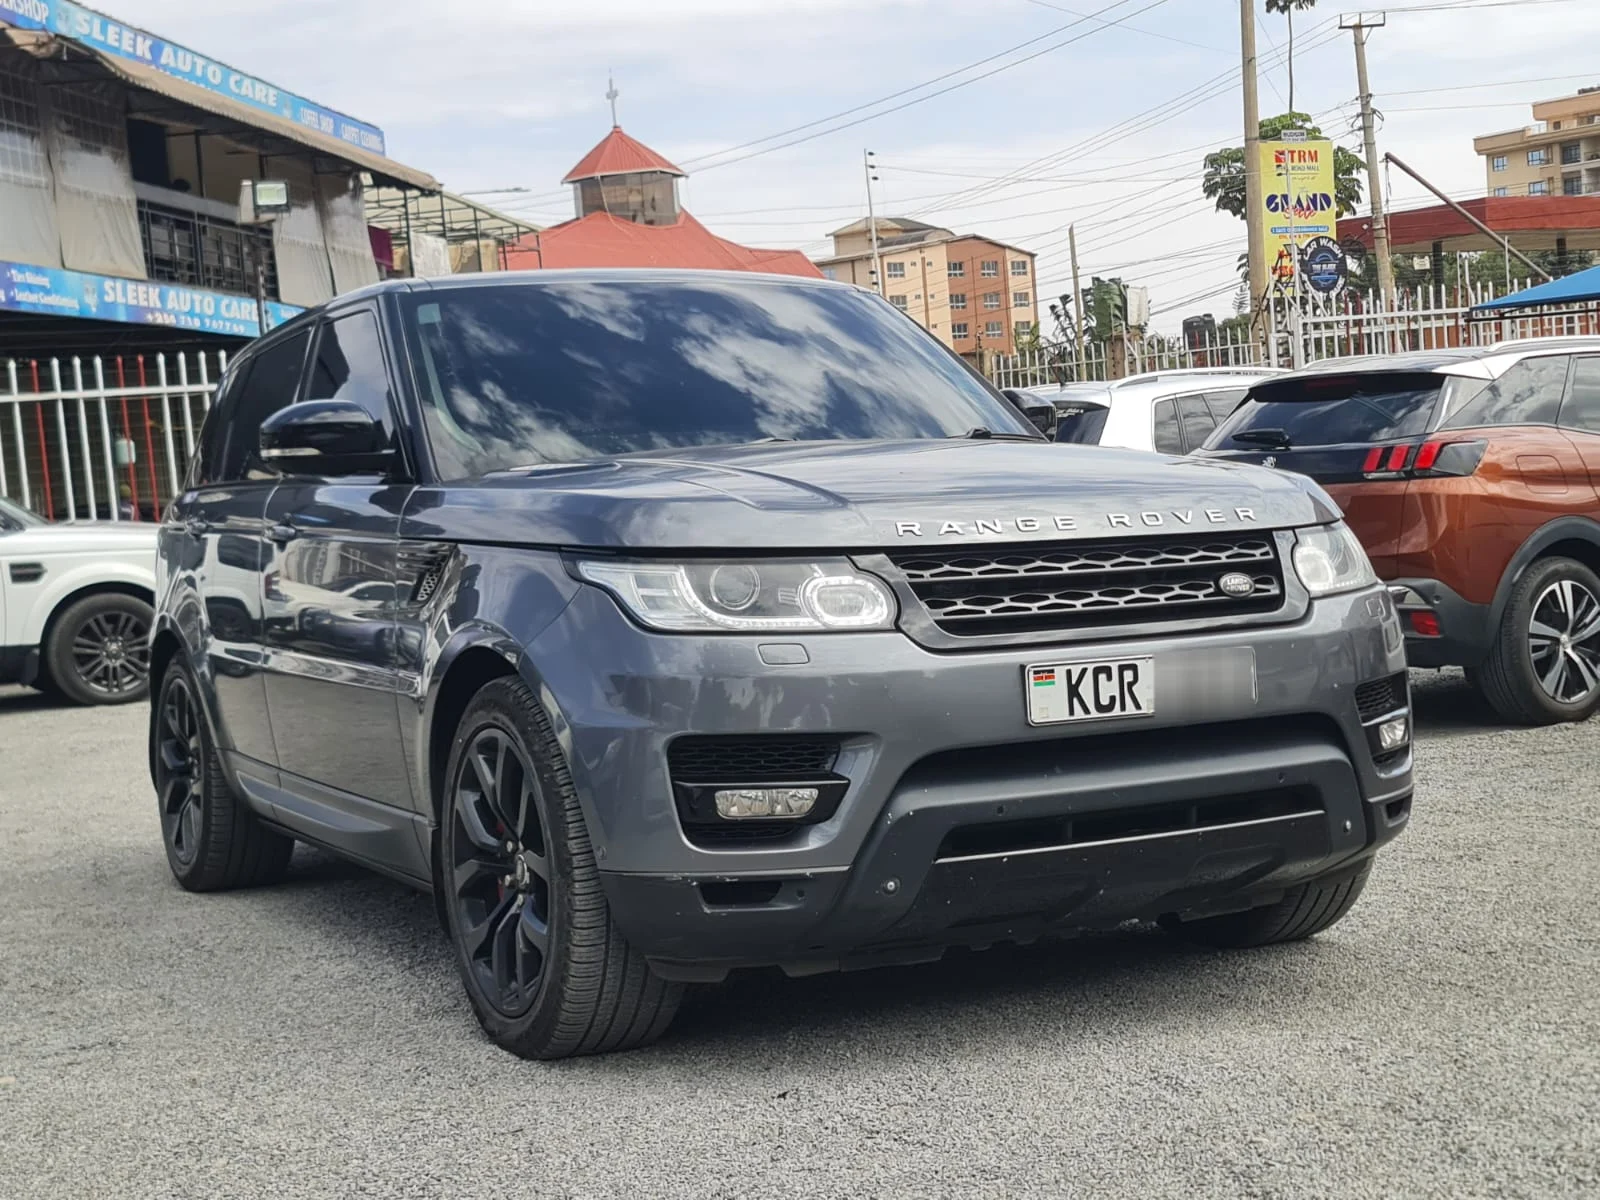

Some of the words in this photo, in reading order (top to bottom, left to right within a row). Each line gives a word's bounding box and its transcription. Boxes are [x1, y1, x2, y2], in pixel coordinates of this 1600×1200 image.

[76, 12, 153, 61] SLEEK
[160, 43, 223, 85] AUTO
[229, 75, 278, 106] CARE
[1288, 149, 1319, 164] TRM
[1265, 192, 1332, 213] GRAND
[1303, 240, 1318, 260] CAR
[1319, 237, 1344, 258] WASH
[103, 280, 161, 306] SLEEK
[166, 291, 215, 316] AUTO
[220, 301, 258, 323] CARE
[896, 515, 1078, 537] RANGE
[1107, 507, 1257, 528] ROVER
[1226, 577, 1244, 586] LAND
[1230, 584, 1251, 593] ROVER
[1066, 662, 1143, 717] KCR
